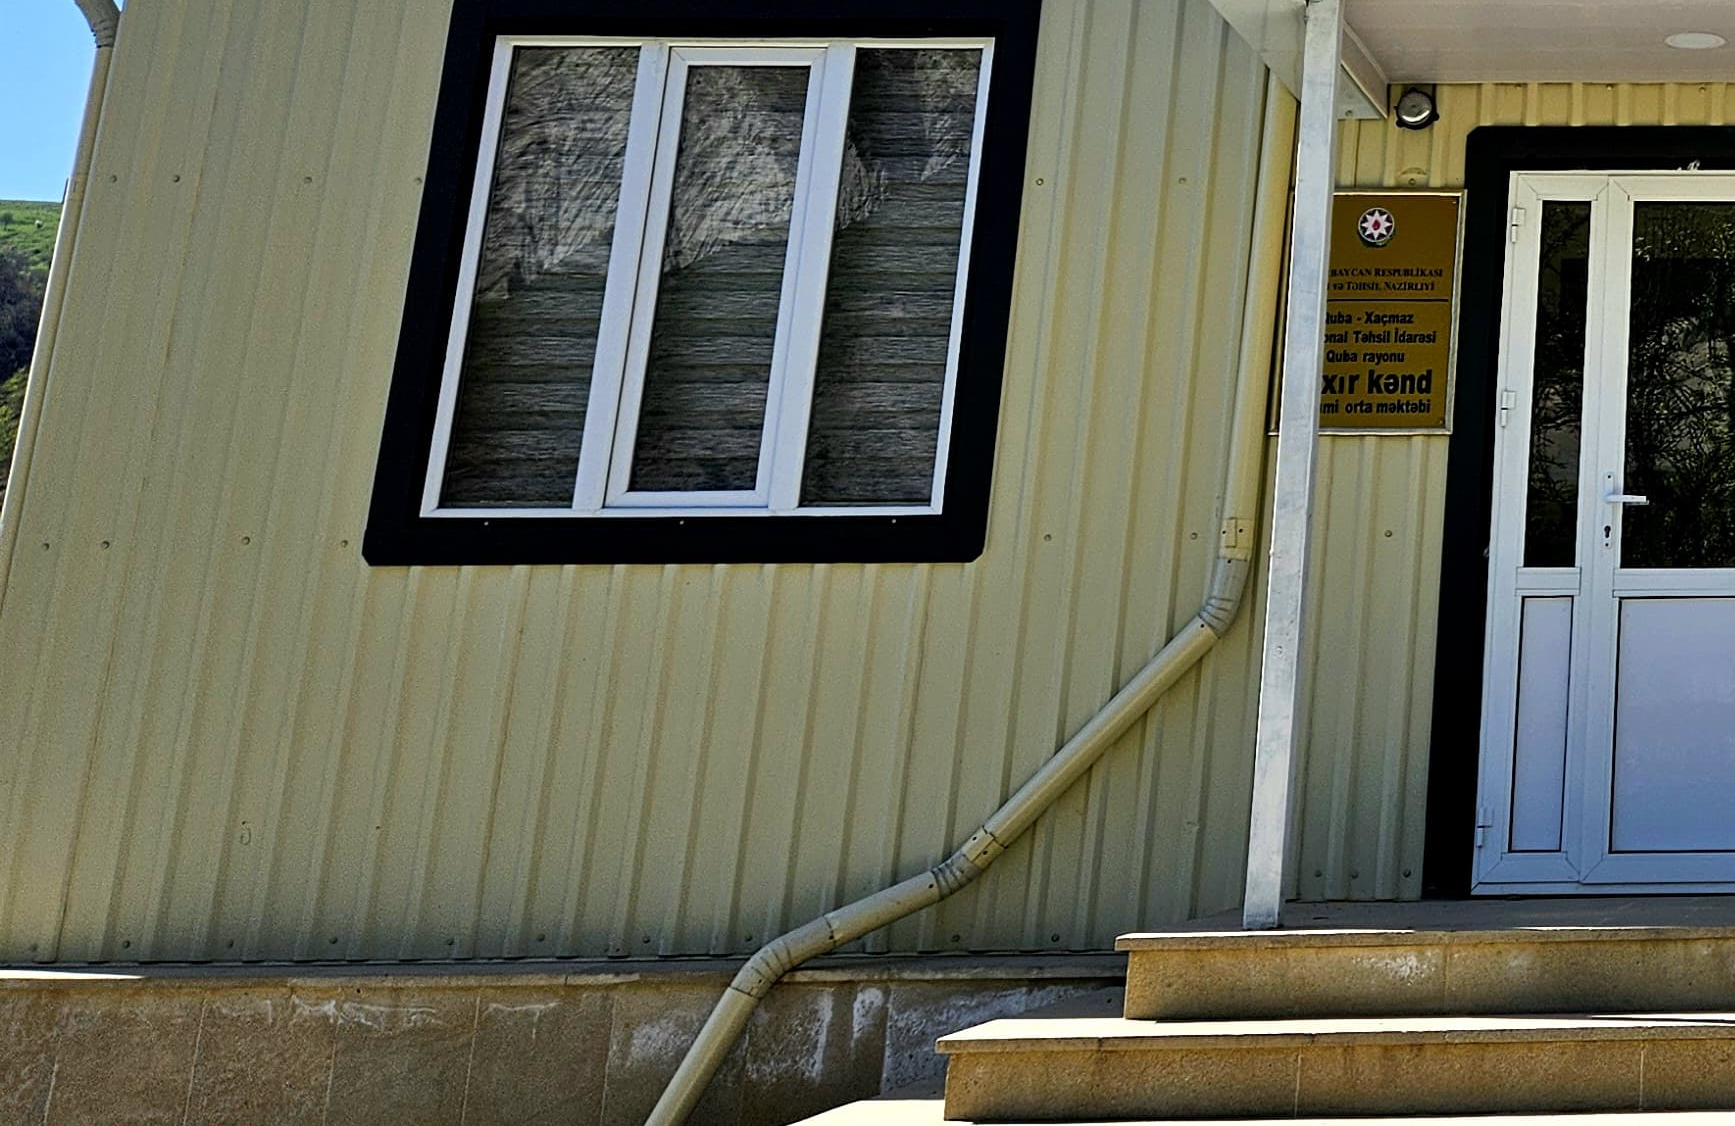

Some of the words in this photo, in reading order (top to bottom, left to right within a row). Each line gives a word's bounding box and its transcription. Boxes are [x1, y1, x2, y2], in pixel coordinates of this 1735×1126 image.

[1330, 267, 1372, 277] BAYCAN
[1364, 311, 1415, 326] Xaçmaz
[1353, 330, 1391, 343] Təhsil
[1394, 327, 1437, 343] İdarəsi
[1326, 349, 1358, 363] Quba
[1362, 351, 1405, 365] rayonu
[1321, 374, 1360, 394] xır
[1367, 369, 1433, 394] kənd
[1345, 400, 1373, 414] orta
[1376, 399, 1431, 414] məktəbi
